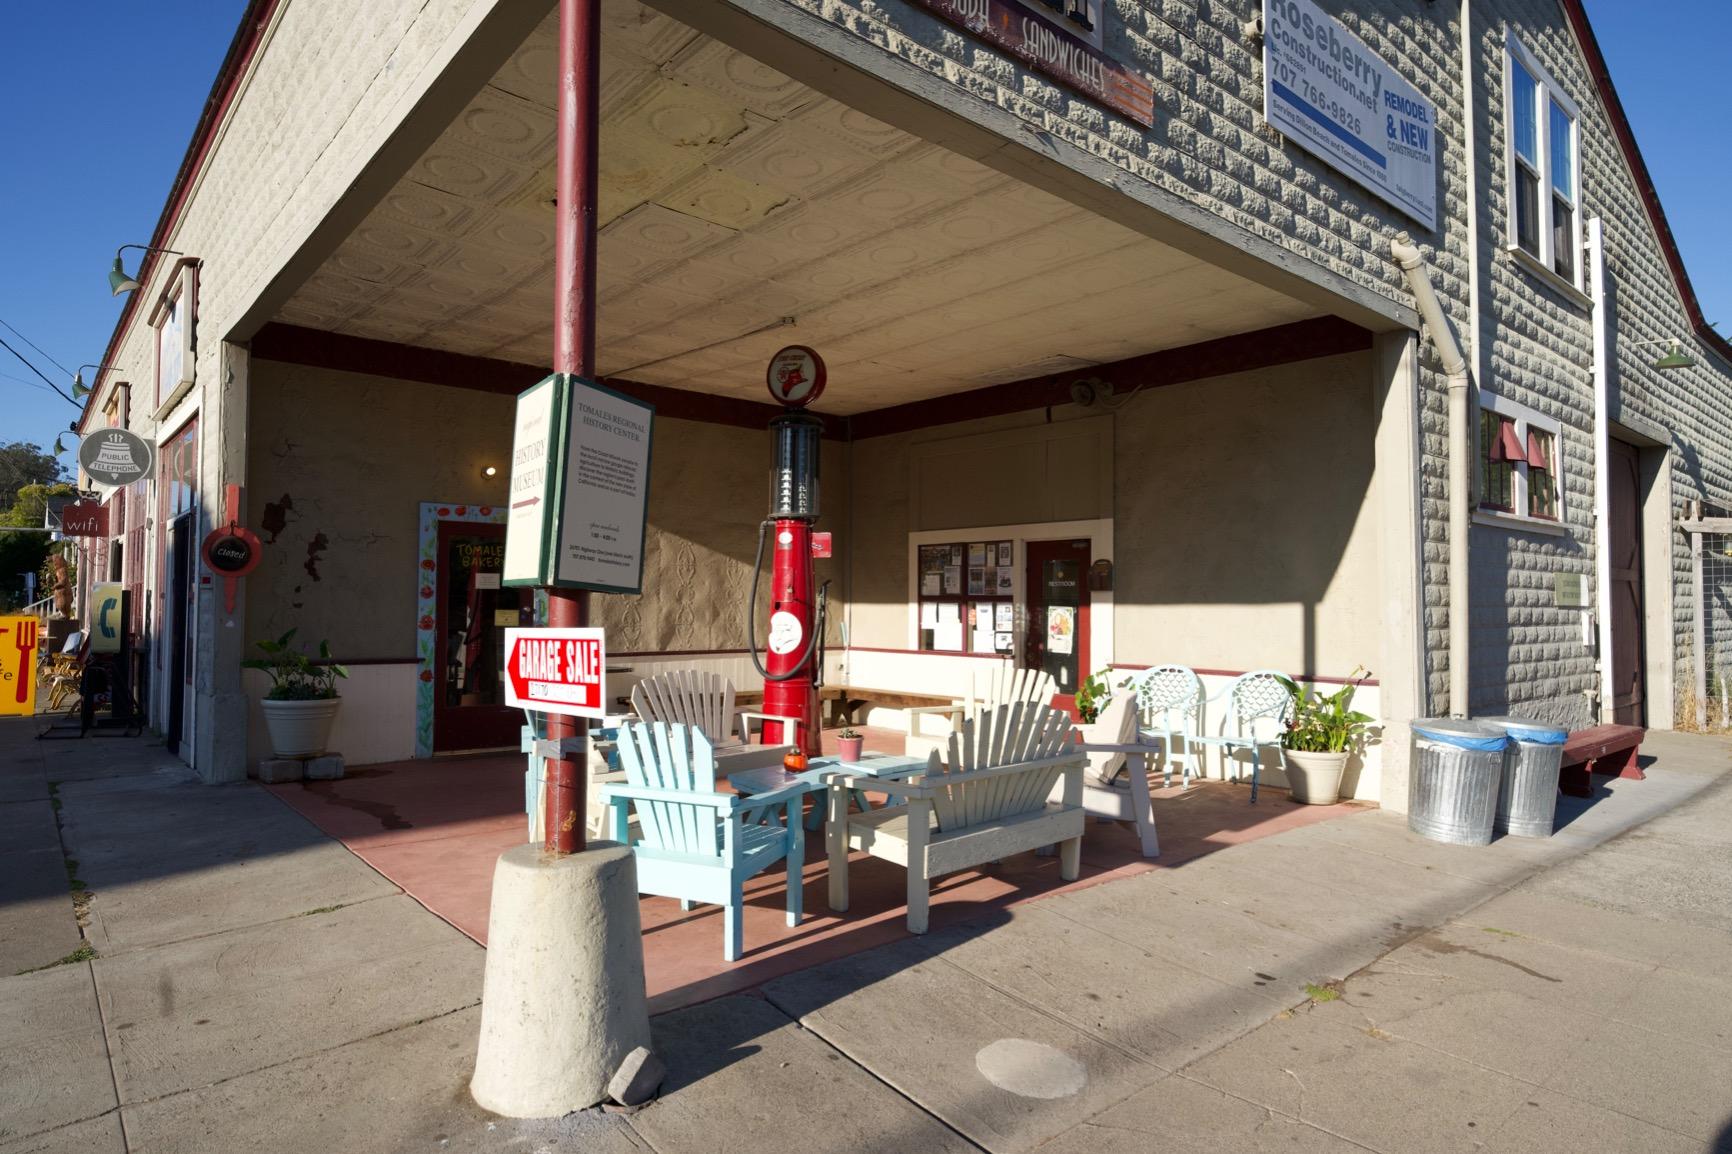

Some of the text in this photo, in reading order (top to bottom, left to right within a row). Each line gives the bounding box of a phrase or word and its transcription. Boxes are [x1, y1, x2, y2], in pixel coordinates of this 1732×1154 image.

[1022, 16, 1105, 91] SANDWICHES
[1271, 18, 1379, 114] Construction.net
[1272, 57, 1297, 88] 707
[1302, 79, 1361, 135] 766-9826
[1384, 90, 1428, 123] REMODEL
[1273, 100, 1296, 122] Serving
[1386, 115, 1428, 150] & NEW
[1387, 141, 1432, 164] CONSTRUCTION
[578, 403, 646, 433] TOMALES REGIONAL
[583, 416, 640, 442] HISTORY CENTER
[101, 453, 129, 461] PUBLIC
[515, 438, 546, 467] HISTORY
[93, 462, 138, 472] TELEPHONE
[512, 467, 544, 494] MUSEUM
[67, 517, 98, 532] wifi
[456, 543, 504, 557] TOMALE
[519, 639, 599, 684] GARAGE SALE
